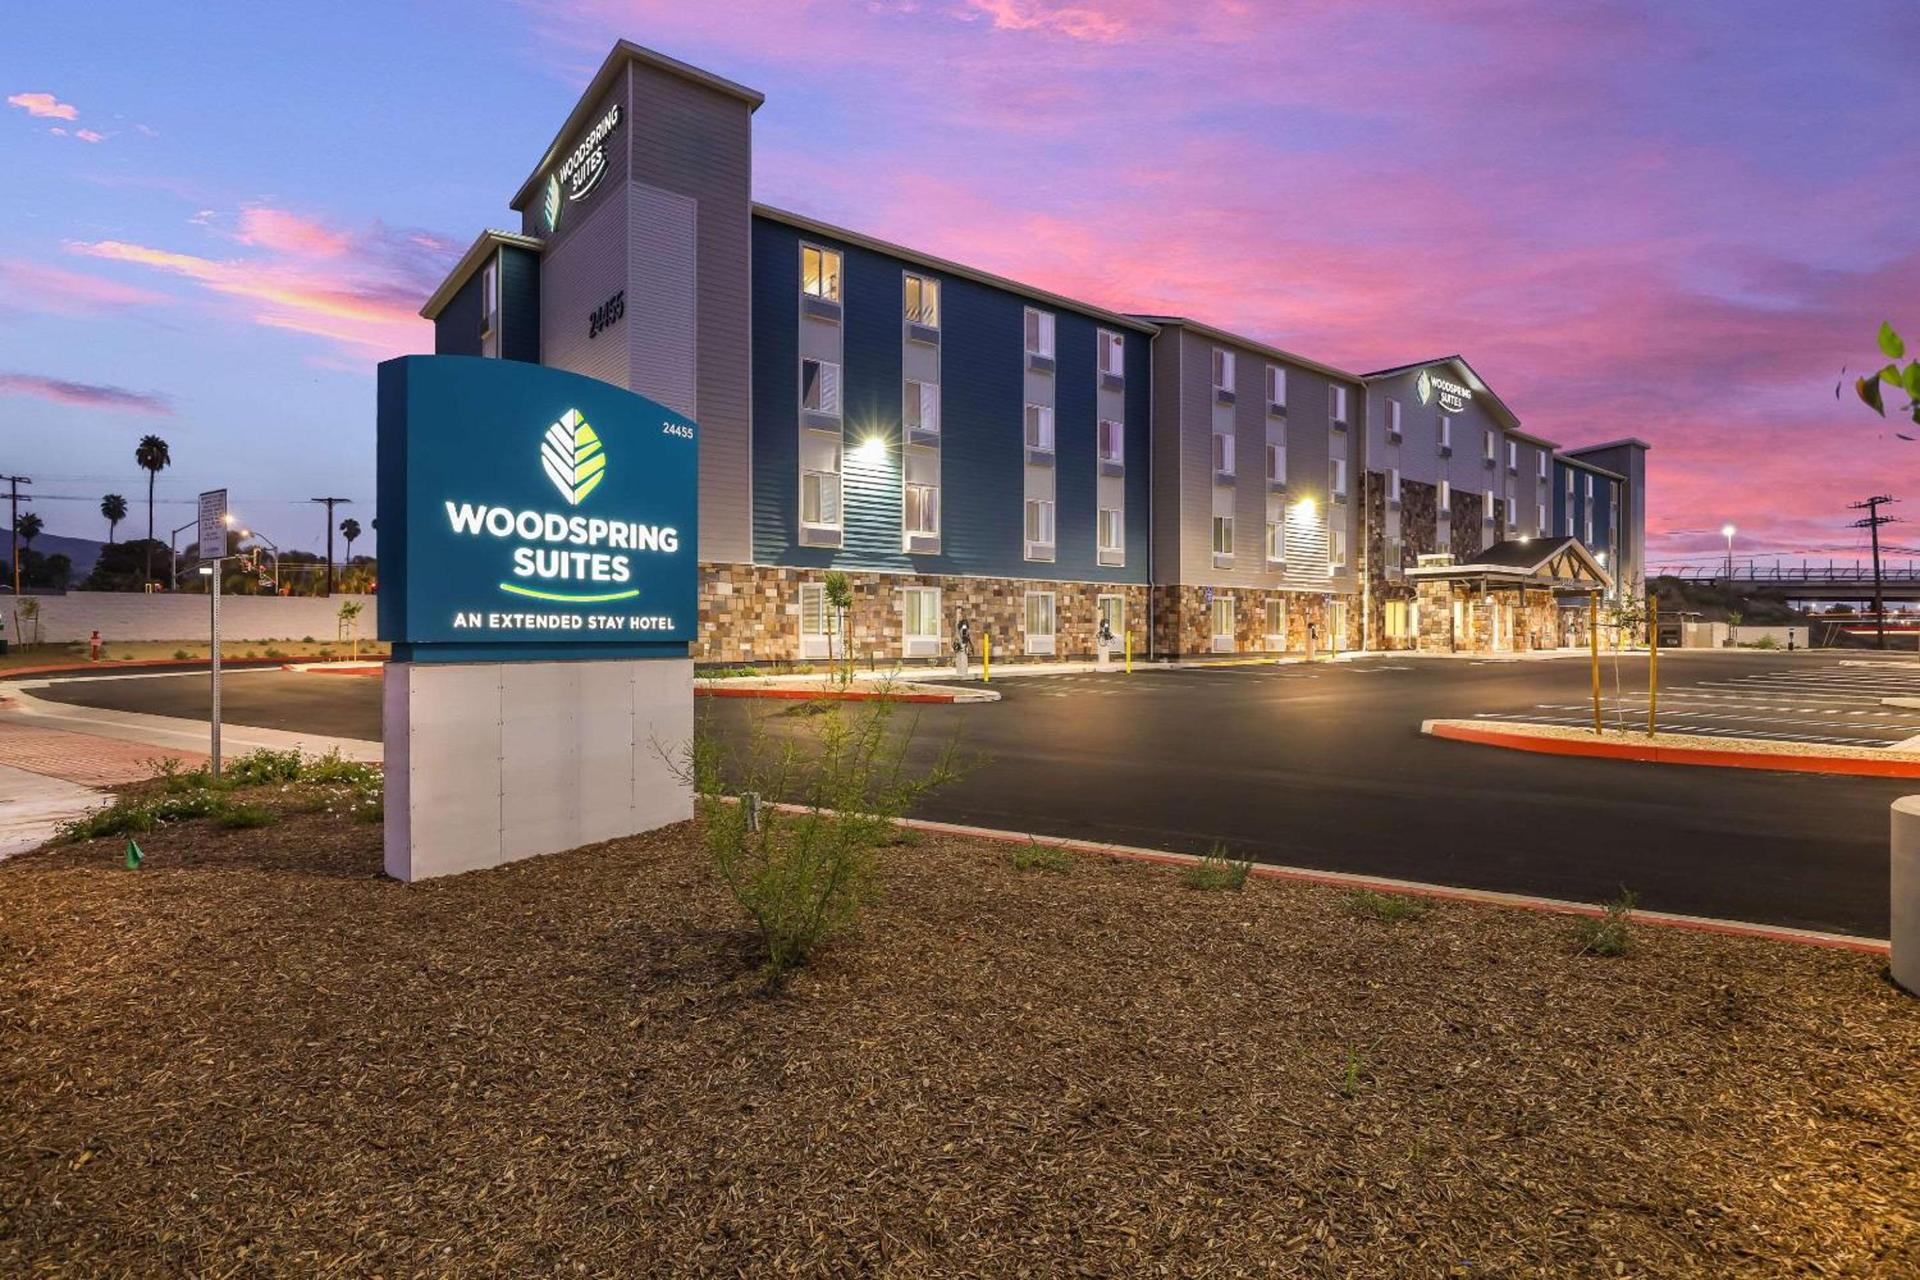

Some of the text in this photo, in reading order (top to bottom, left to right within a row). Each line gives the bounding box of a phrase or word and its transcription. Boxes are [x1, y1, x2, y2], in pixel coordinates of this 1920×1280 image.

[559, 104, 618, 184] WOODSPRING
[572, 145, 603, 191] SUITES
[589, 290, 624, 339] 24455
[1430, 375, 1472, 400] WOODSPRING
[1440, 392, 1462, 408] SUITES
[662, 421, 694, 439] 24455
[445, 501, 678, 553] WOODSPRING
[513, 547, 630, 582] SUITES
[453, 612, 675, 630] AN EXTENDED STAY HOTEL
